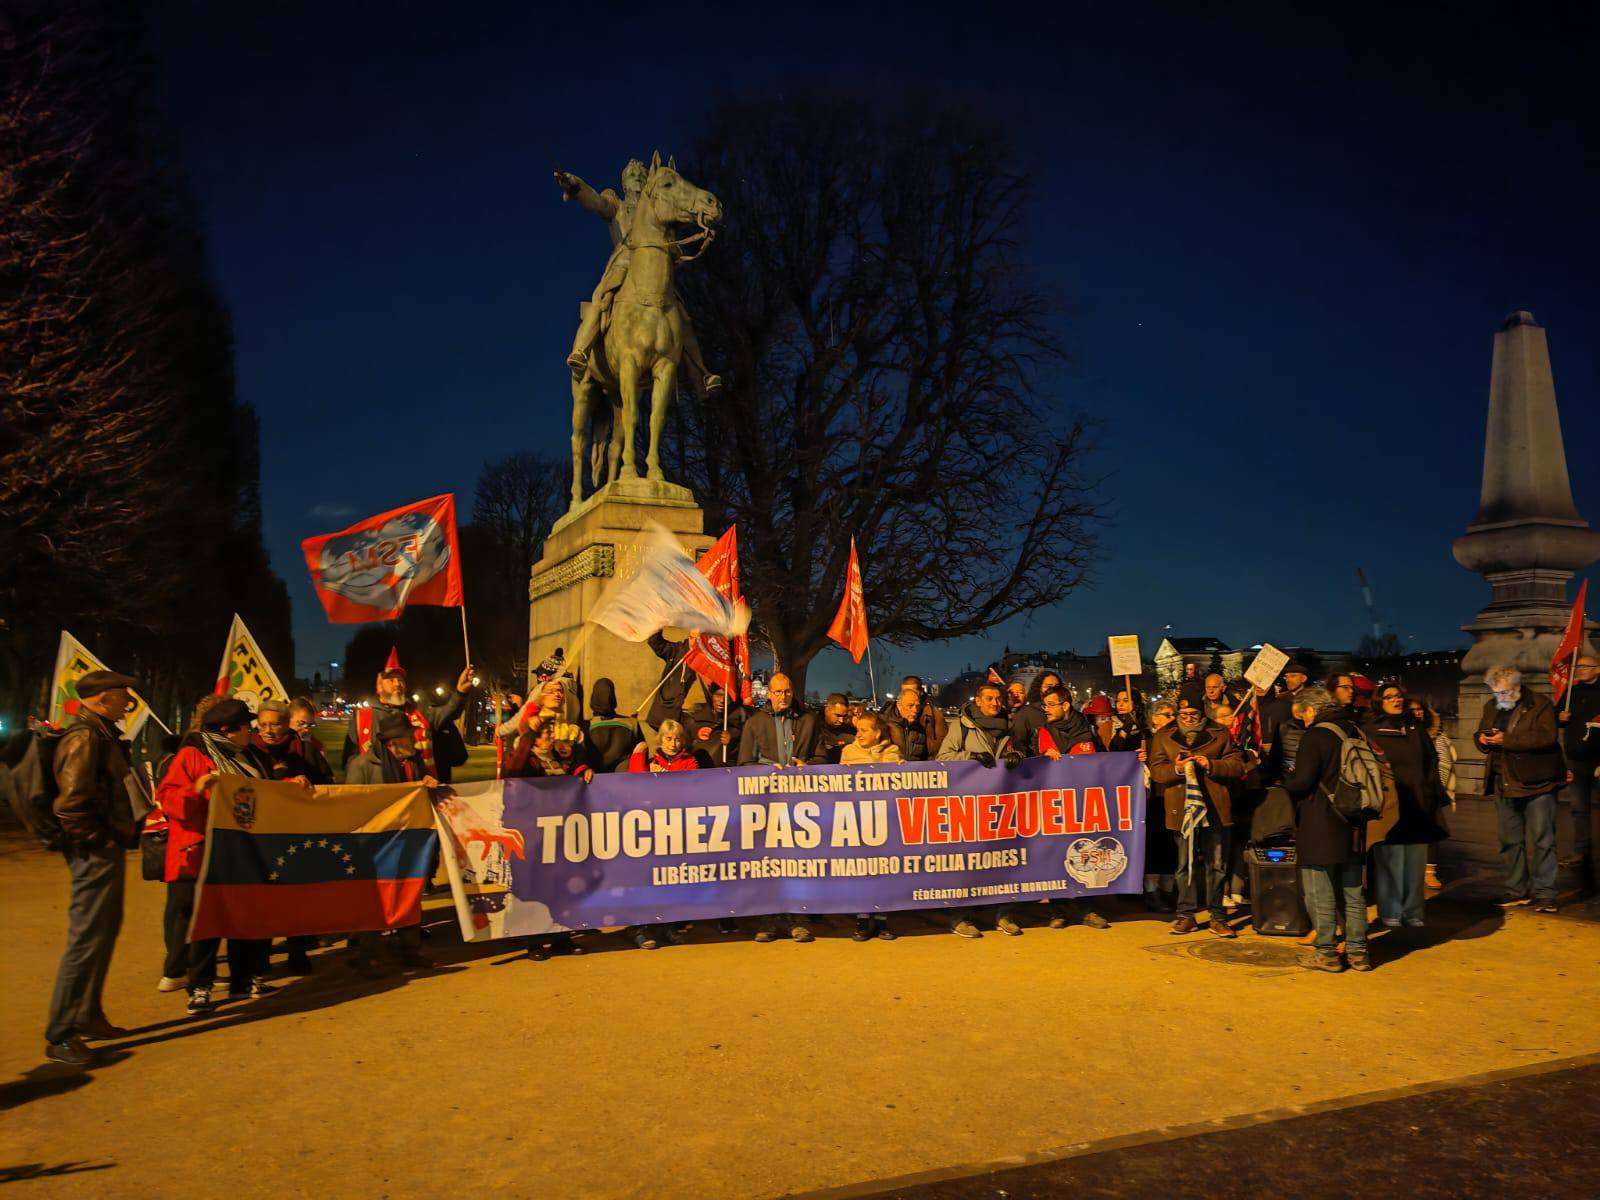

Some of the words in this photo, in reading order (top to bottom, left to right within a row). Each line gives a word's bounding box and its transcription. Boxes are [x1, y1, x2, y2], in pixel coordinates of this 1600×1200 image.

[737, 773, 853, 796] IMPÉRIALISME
[854, 771, 948, 792] ÉTATSUNIEN
[536, 805, 730, 864] TOUCHEZ
[740, 801, 821, 850] PAS
[831, 800, 888, 848] AU
[896, 787, 1111, 845] VENEZUELA
[1117, 785, 1133, 831] !
[653, 862, 717, 886] LIBÉREZ
[720, 862, 737, 881] LE
[740, 856, 827, 880] PRÉSIDENT
[831, 856, 900, 877] MADURO
[903, 855, 921, 873] ET
[924, 853, 965, 873] CILIA
[968, 849, 1018, 871] FLORES
[912, 887, 969, 901] FÉDÉRATION
[970, 883, 1020, 898] SYNDICALE
[1020, 879, 1068, 893] MONDIALE
